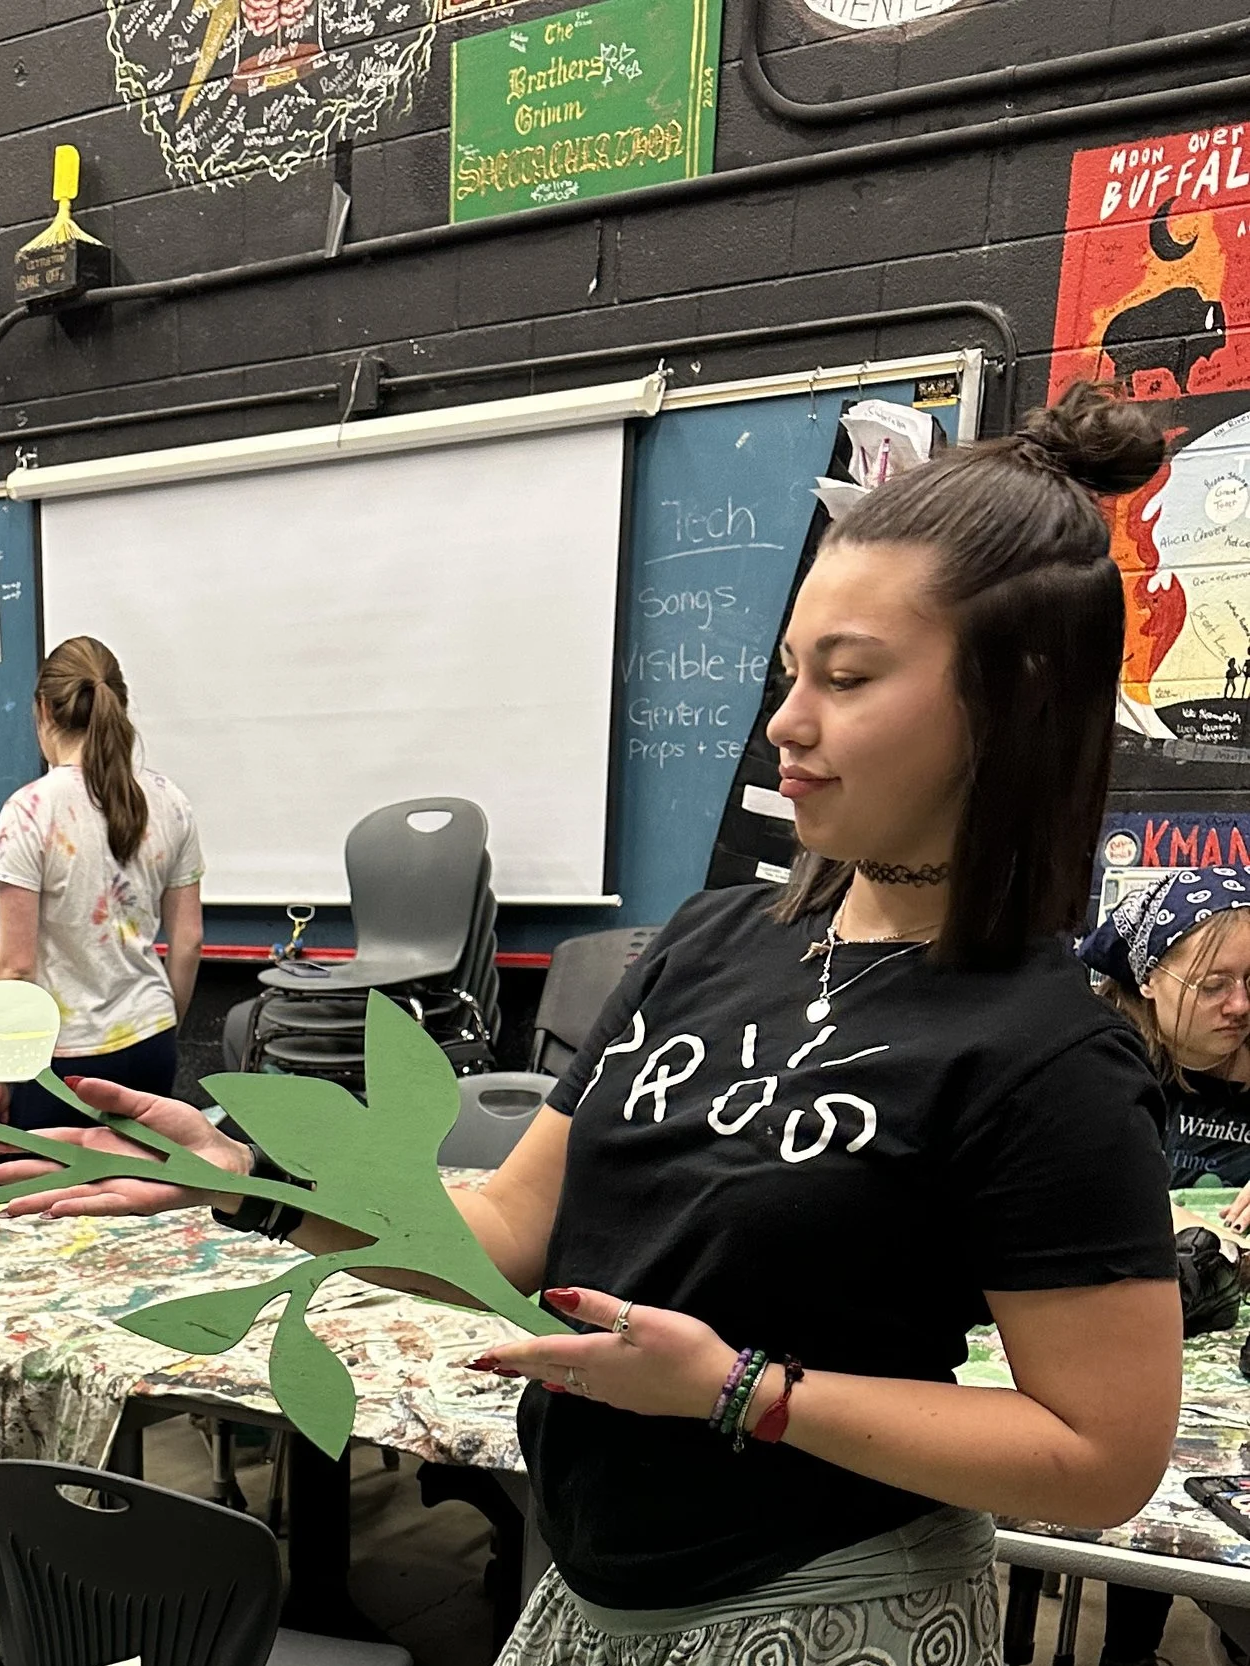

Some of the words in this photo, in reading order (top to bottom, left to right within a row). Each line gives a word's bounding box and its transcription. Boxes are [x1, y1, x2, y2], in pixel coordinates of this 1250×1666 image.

[544, 21, 574, 45] The
[507, 55, 604, 104] Brothers
[702, 67, 714, 108] 2024
[514, 99, 587, 136] Grimm
[1109, 146, 1164, 174] MOON
[661, 496, 756, 543] Tech
[621, 643, 725, 684] Visible
[629, 697, 731, 731] Generic
[629, 738, 685, 769] Props
